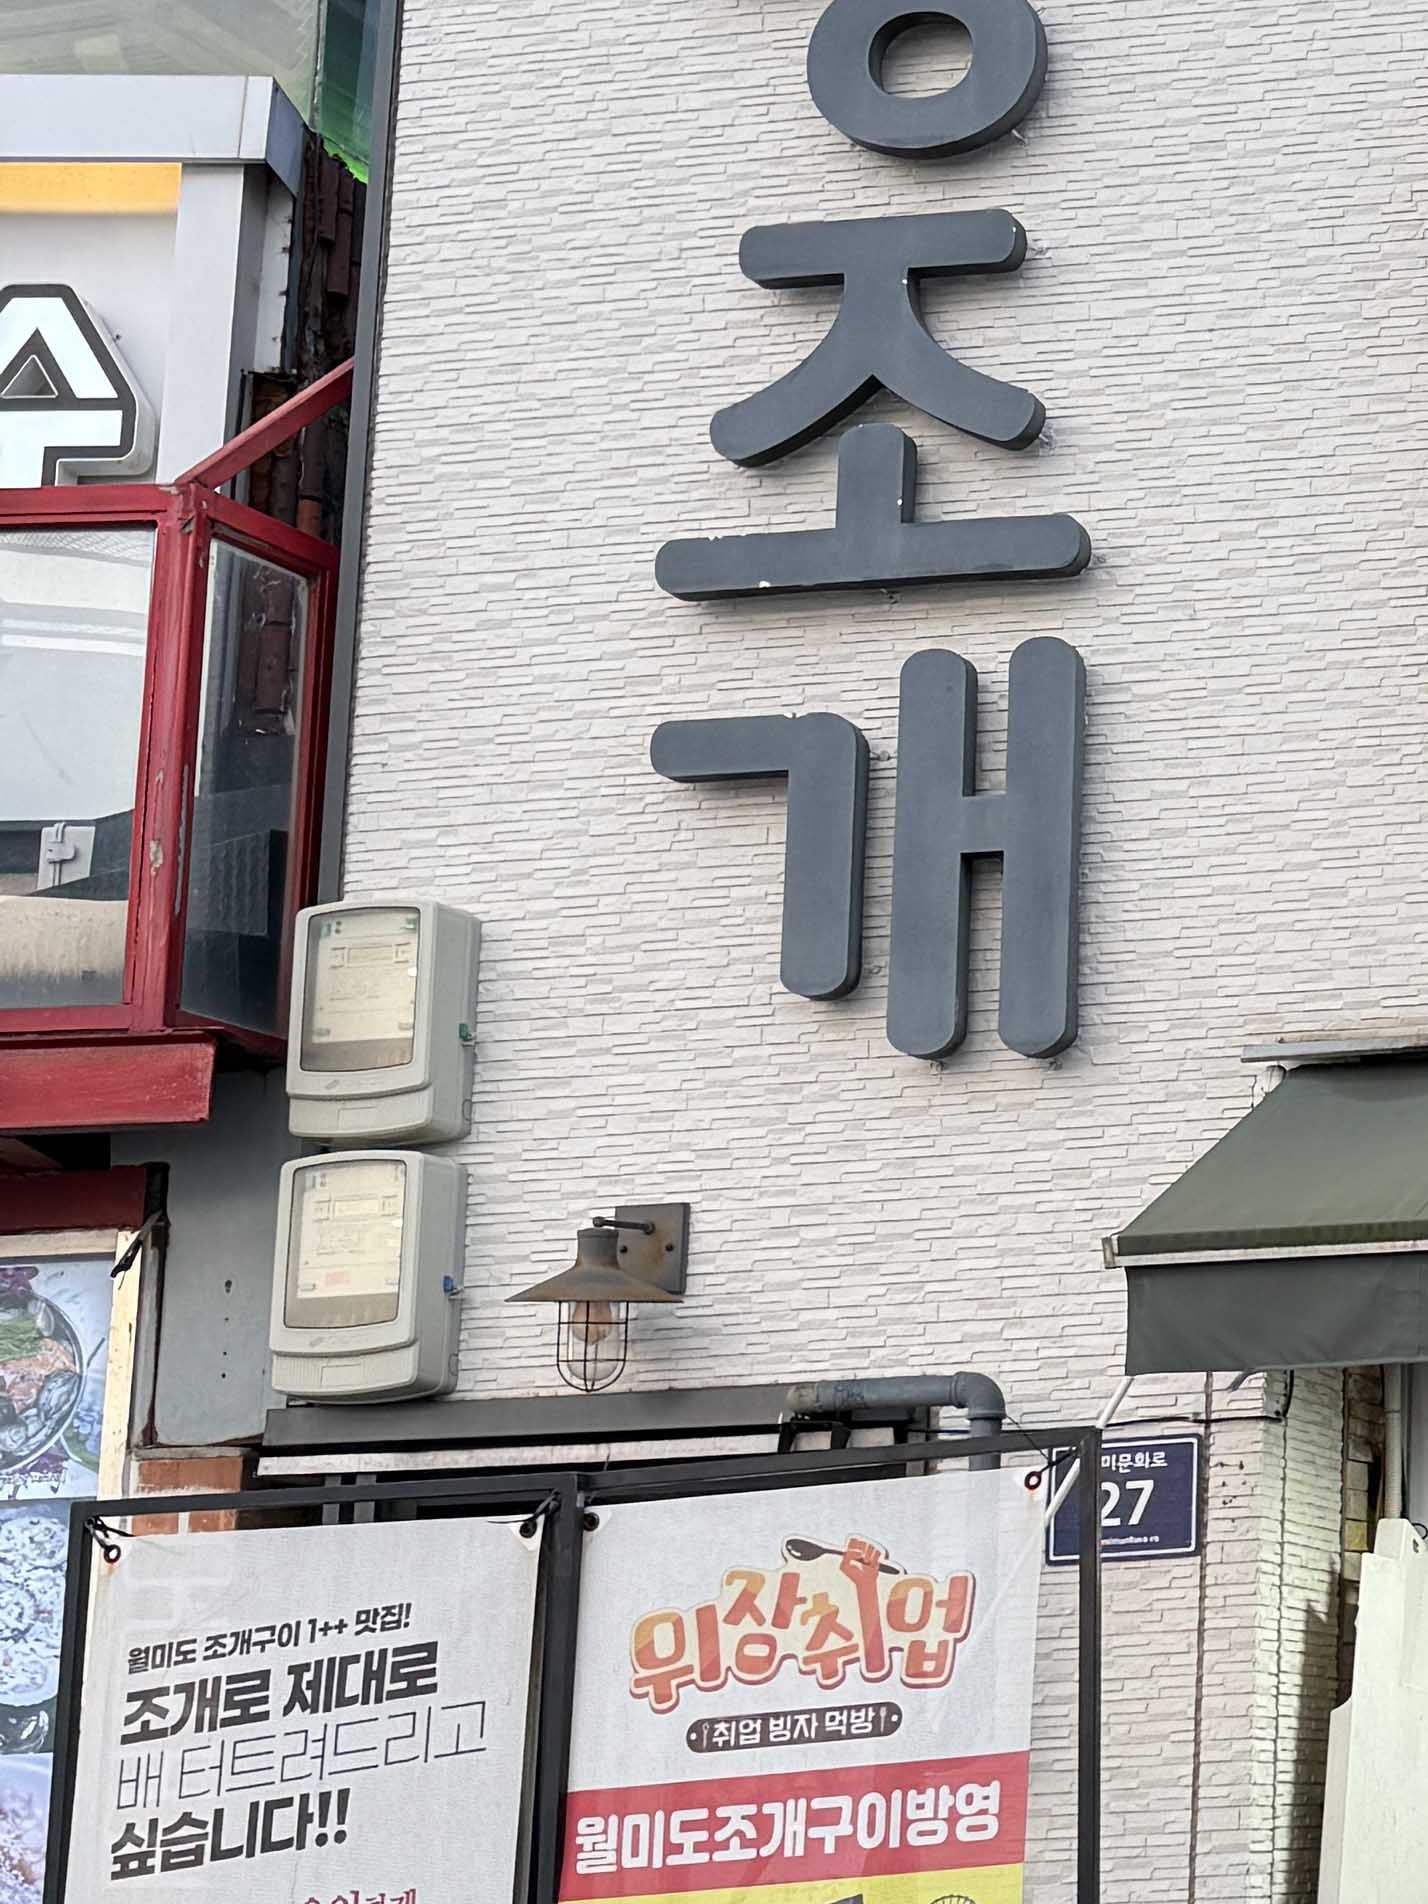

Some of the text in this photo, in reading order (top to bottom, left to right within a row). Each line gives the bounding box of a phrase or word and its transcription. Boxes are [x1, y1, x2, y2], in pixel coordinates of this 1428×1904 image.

[1101, 1451, 1169, 1474] 미문화로
[128, 1603, 412, 1675] 월미도 조개구이 1++ 맛집!
[632, 1538, 972, 1708] 위장취업
[120, 1641, 439, 1746] 조개로 제대로
[712, 1707, 876, 1749] 취업 빙자 먹방
[116, 1700, 488, 1811] 배 터트려드리고
[110, 1787, 352, 1881] 싶습니다!!
[574, 1779, 1002, 1876] 월미도조개구이방영
